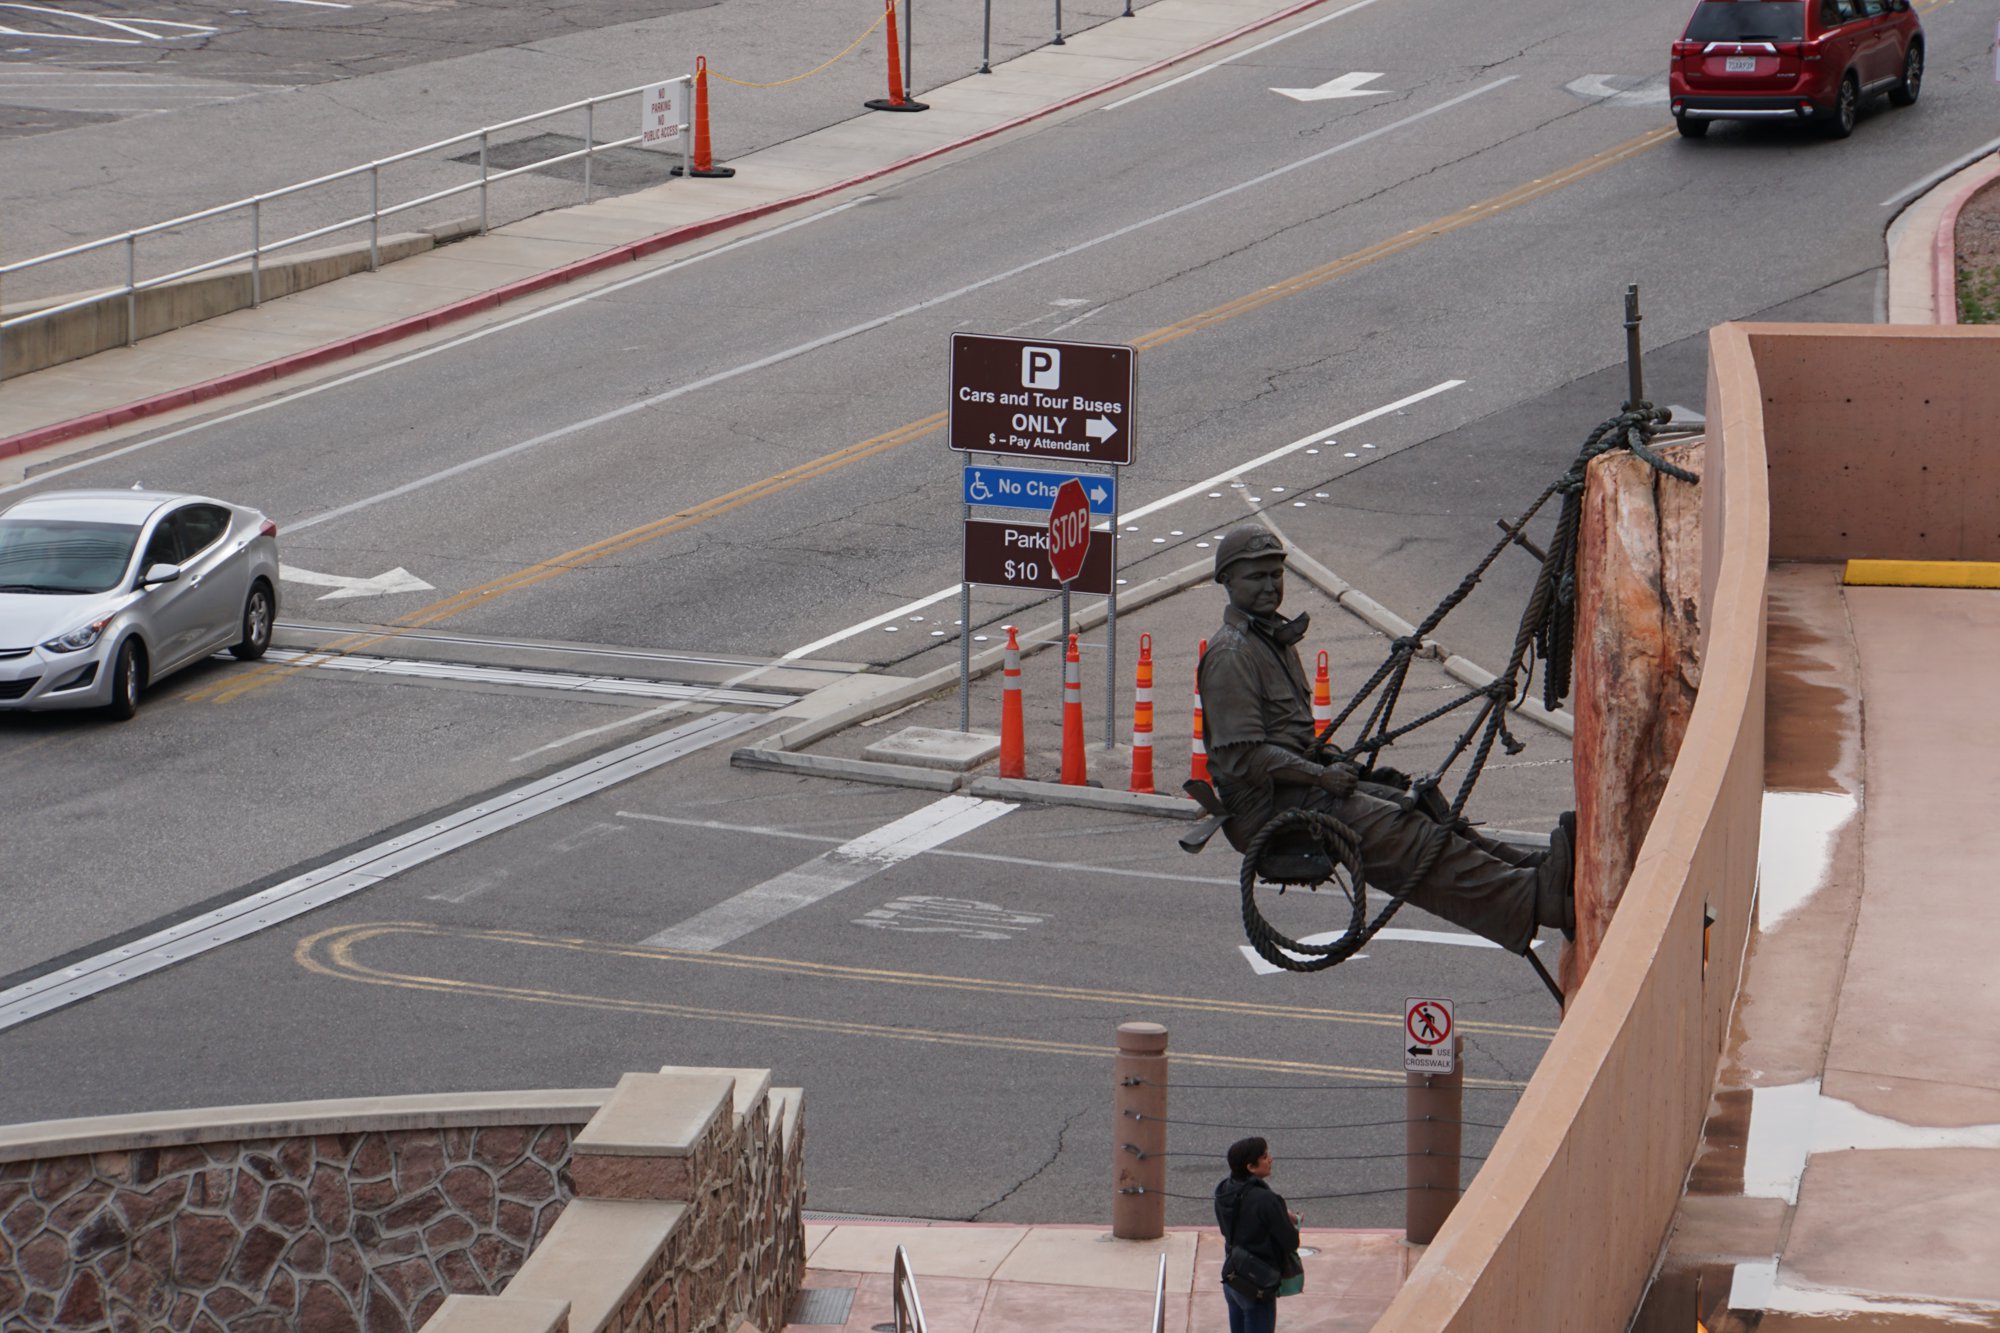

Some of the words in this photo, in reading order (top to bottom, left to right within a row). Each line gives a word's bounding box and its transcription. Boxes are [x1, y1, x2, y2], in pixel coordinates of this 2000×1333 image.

[659, 88, 665, 99] NO
[652, 100, 671, 113] PARKING
[658, 114, 664, 125] NO
[644, 129, 660, 141] PUBLIC
[660, 124, 678, 138] ACCESS
[1029, 351, 1053, 384] P
[959, 386, 995, 404] Cars
[999, 392, 1029, 407] and
[1033, 392, 1069, 409] Tour
[1073, 396, 1122, 414] Buses
[1011, 413, 1067, 435] ONLY
[988, 432, 996, 445] $
[1009, 435, 1031, 449] Pay
[1034, 437, 1090, 452] Attendant
[998, 478, 1021, 495] No
[1026, 480, 1058, 497] Cha
[1004, 529, 1049, 550] Parki
[1051, 507, 1087, 554] STOP
[1004, 559, 1038, 581] $10
[1437, 1048, 1451, 1057] USE
[1405, 1058, 1451, 1067] CROSSWALK
